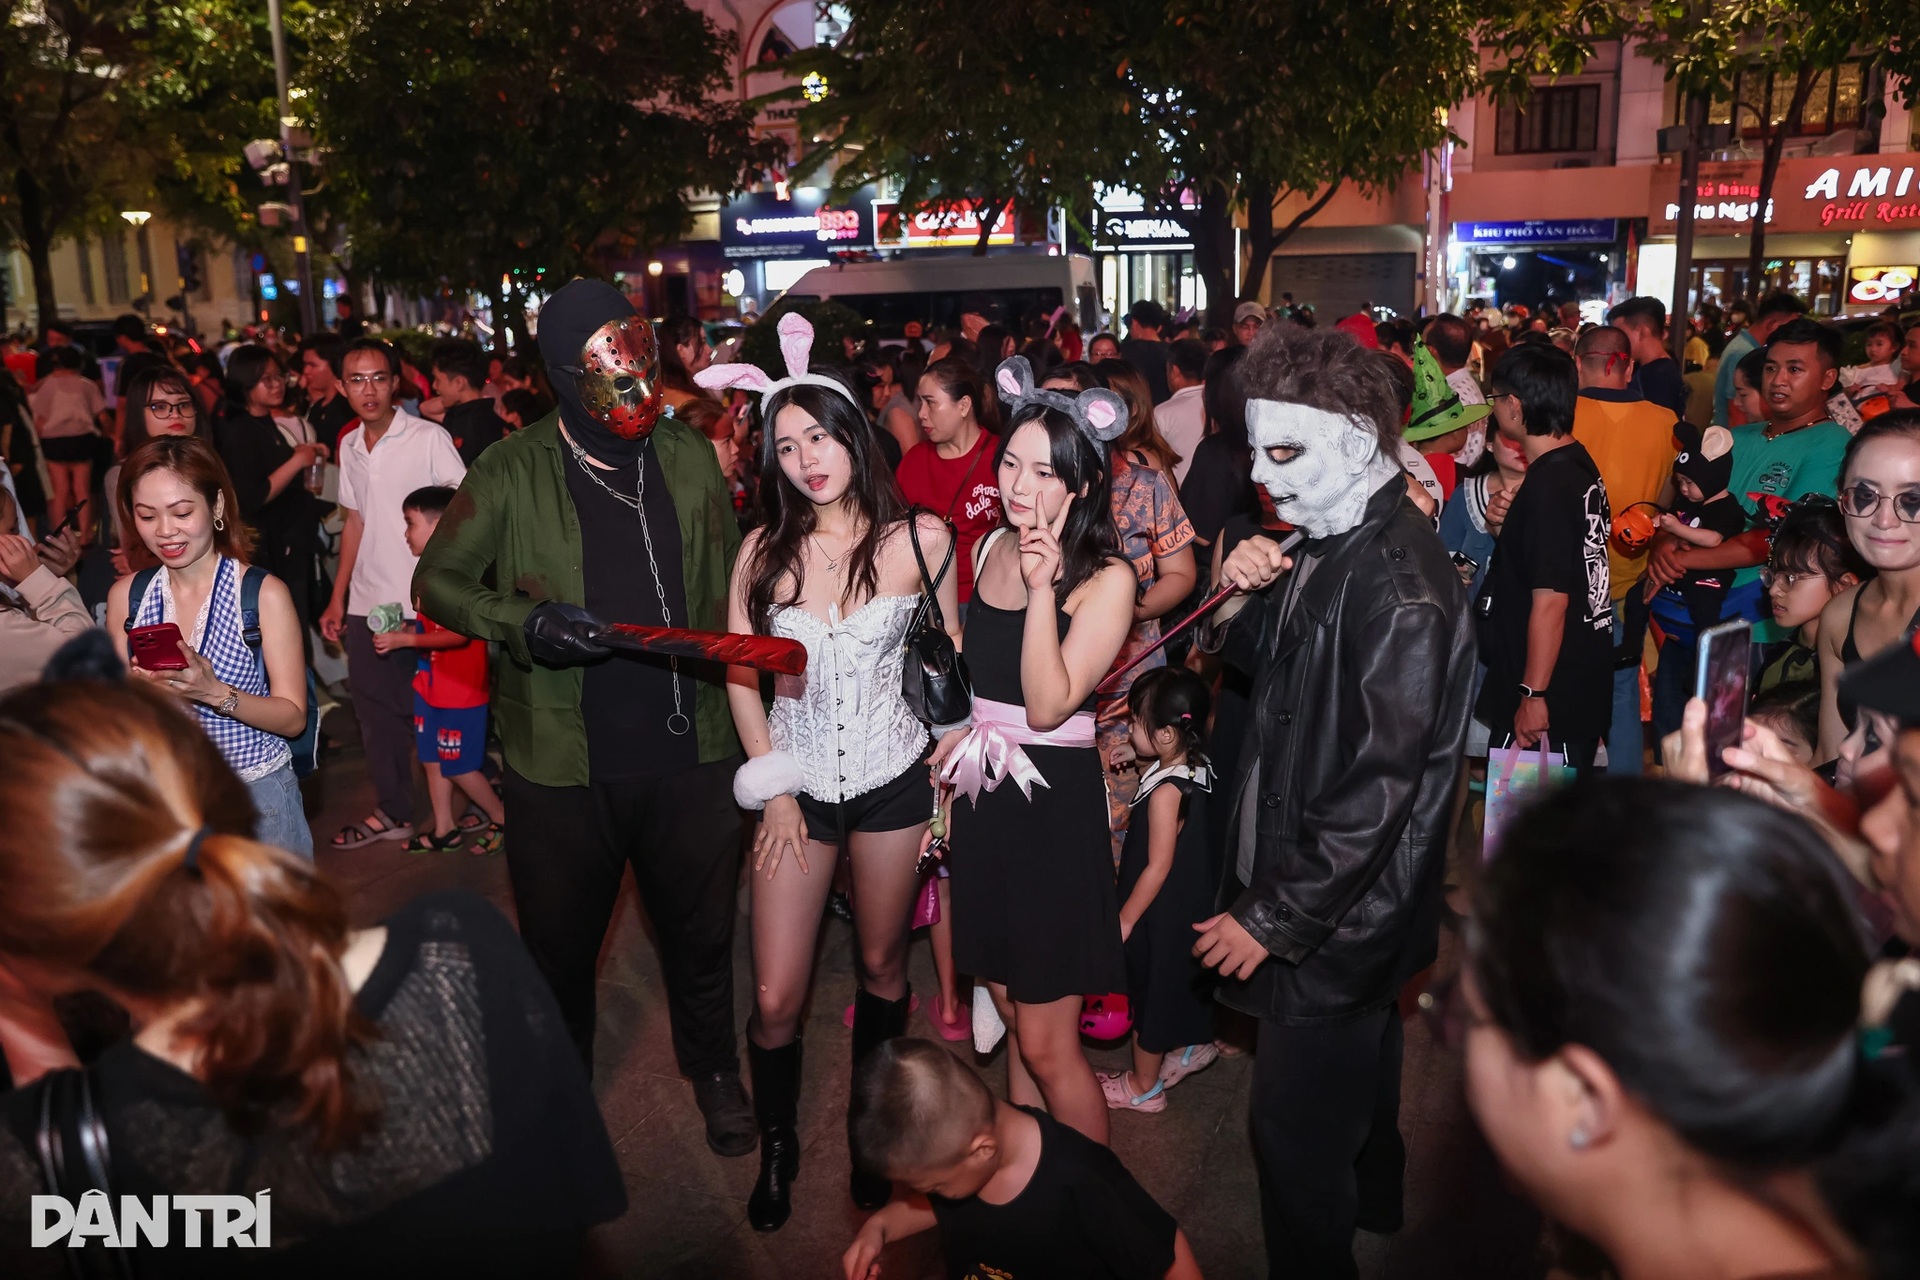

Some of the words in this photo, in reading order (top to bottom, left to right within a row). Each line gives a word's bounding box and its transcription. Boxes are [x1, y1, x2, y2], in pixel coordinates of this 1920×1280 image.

[1804, 167, 1920, 200] AMI
[1821, 202, 1870, 226] Grill
[1876, 202, 1920, 223] Rest
[1473, 226, 1502, 238] KHU
